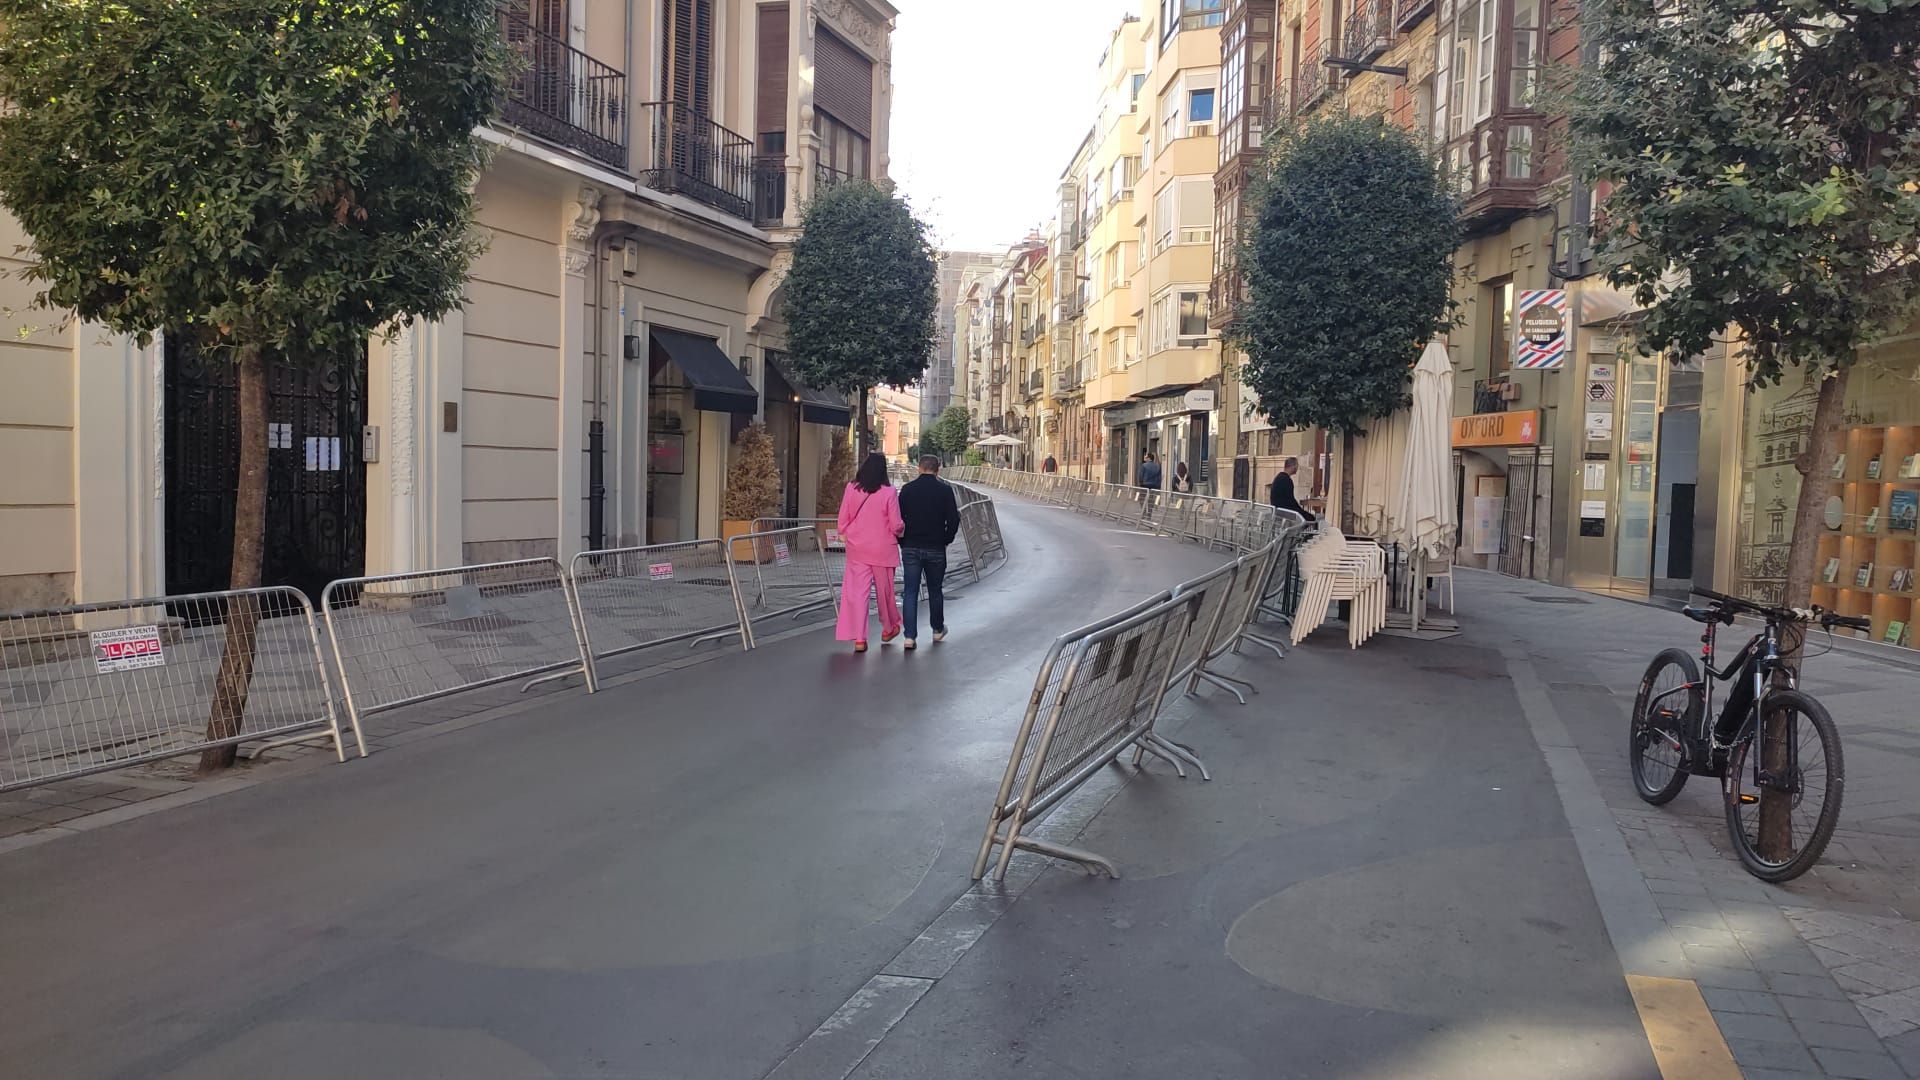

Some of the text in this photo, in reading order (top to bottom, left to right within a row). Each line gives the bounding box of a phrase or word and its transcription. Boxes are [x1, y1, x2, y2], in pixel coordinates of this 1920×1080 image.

[1460, 415, 1505, 439] OXFORD
[93, 630, 127, 639] ALQUILER
[134, 627, 157, 635] VENTA
[96, 640, 158, 657] LAPE
